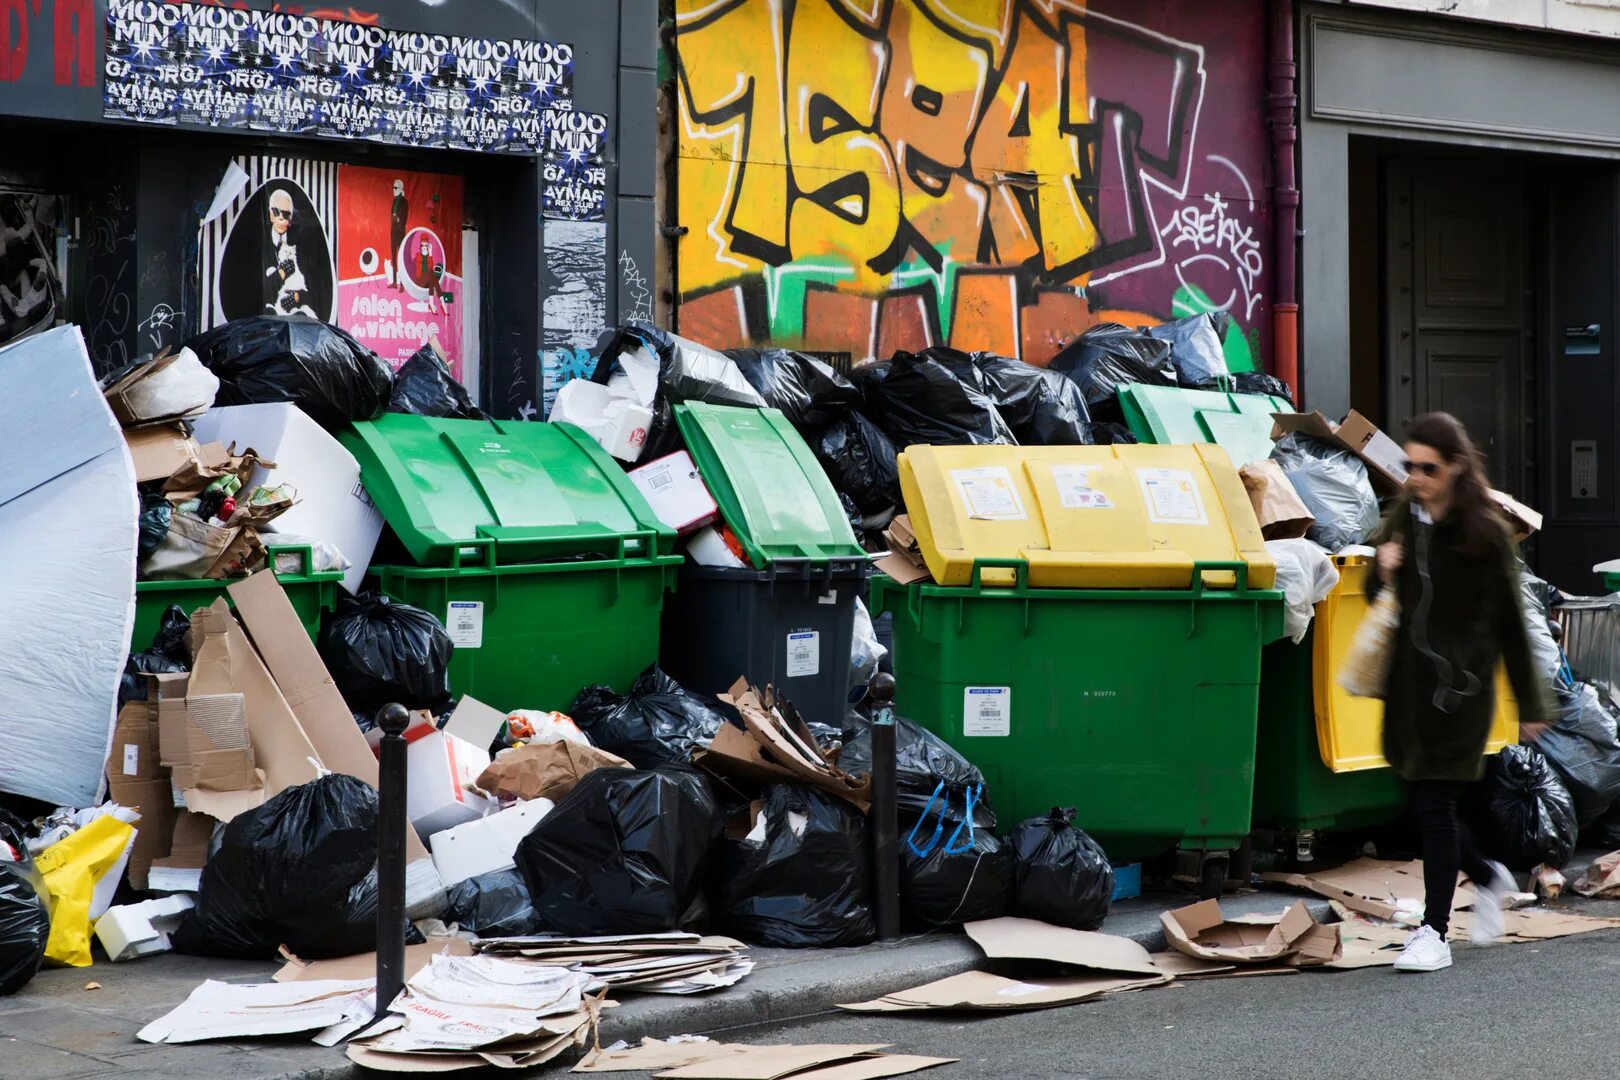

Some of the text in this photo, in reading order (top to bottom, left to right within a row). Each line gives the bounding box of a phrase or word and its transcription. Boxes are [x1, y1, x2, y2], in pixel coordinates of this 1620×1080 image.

[108, 0, 181, 26] MOO
[181, 3, 250, 31] MOO
[252, 10, 319, 38] MOO
[114, 20, 169, 47] MIN
[188, 26, 239, 52] MIN
[258, 33, 308, 59] MIN
[322, 20, 387, 48] MOO
[387, 31, 449, 56] MOO
[327, 41, 375, 69] MIN
[451, 36, 511, 62] MOO
[512, 39, 573, 65] MOO
[392, 51, 439, 76] MIN
[456, 57, 502, 82] MIN
[517, 60, 563, 84] MIN
[545, 109, 607, 134] MOO
[550, 130, 597, 153] MIN
[366, 317, 440, 347] vintage
[407, 1002, 451, 1022] FRAGILE
